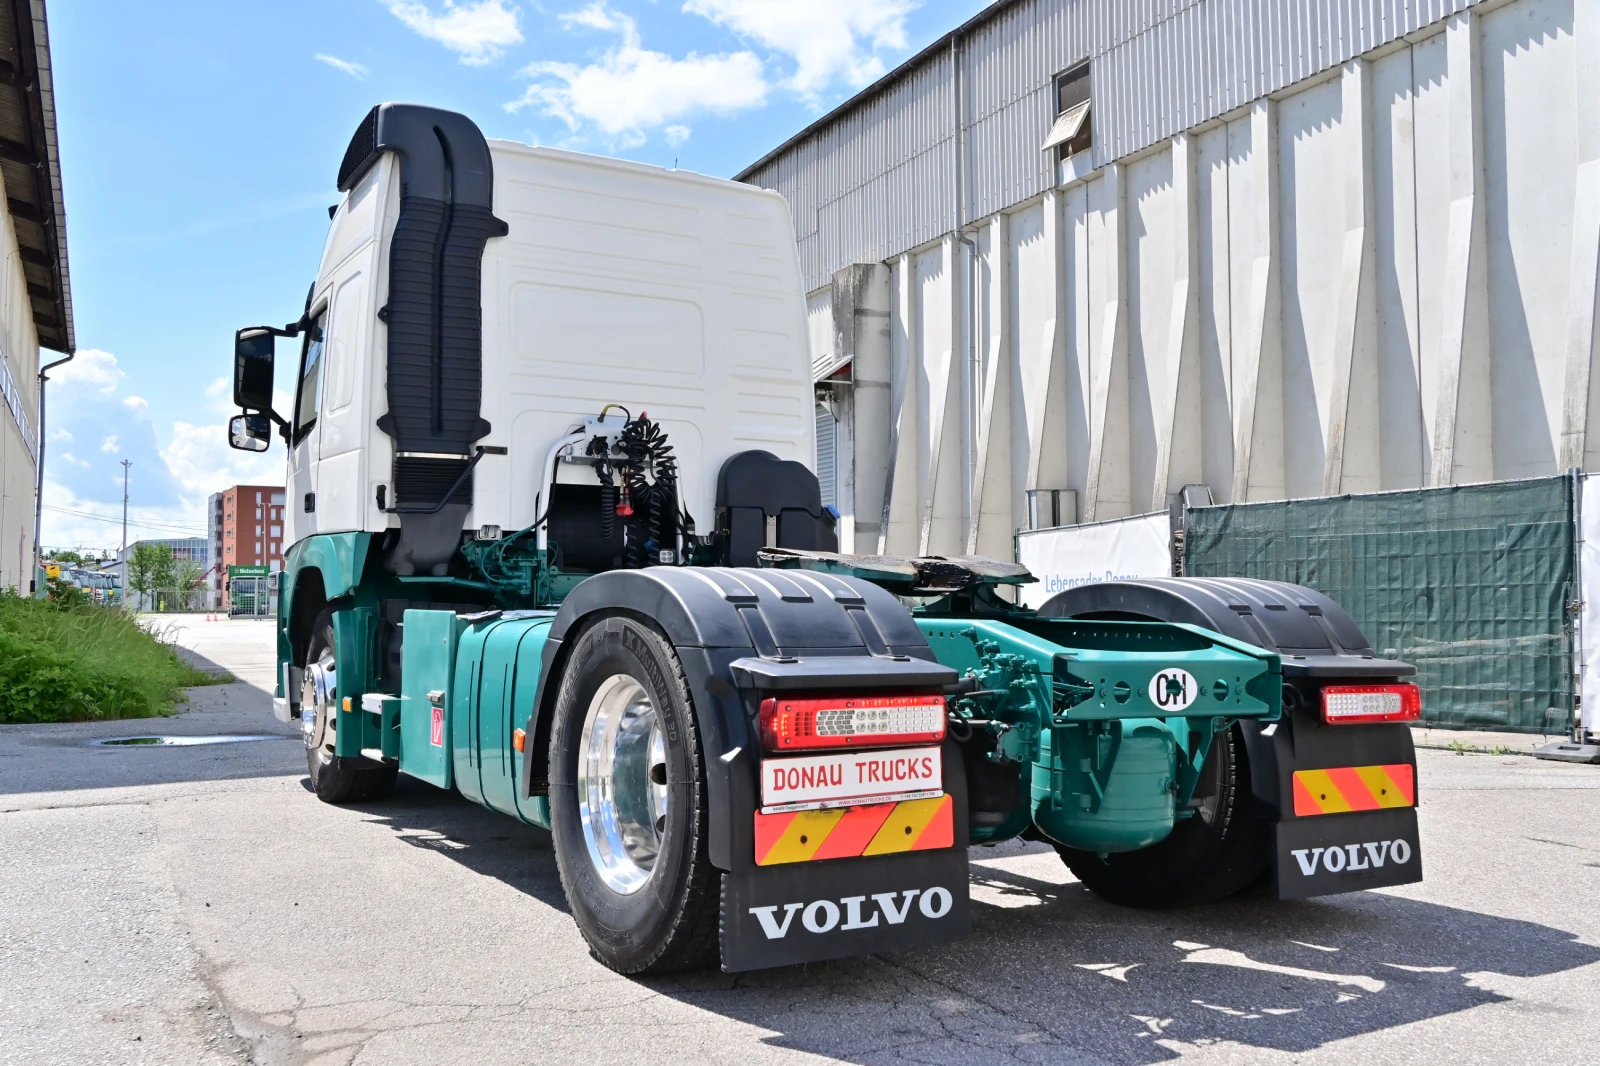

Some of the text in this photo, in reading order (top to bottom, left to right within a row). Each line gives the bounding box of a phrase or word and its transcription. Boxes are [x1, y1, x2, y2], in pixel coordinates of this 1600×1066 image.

[626, 629, 637, 649] X
[667, 721, 677, 741] 30
[1156, 673, 1187, 706] CH
[773, 757, 933, 791] DONAU TRUCKS
[1291, 838, 1412, 876] VOLVO
[749, 886, 953, 939] VOLVO
